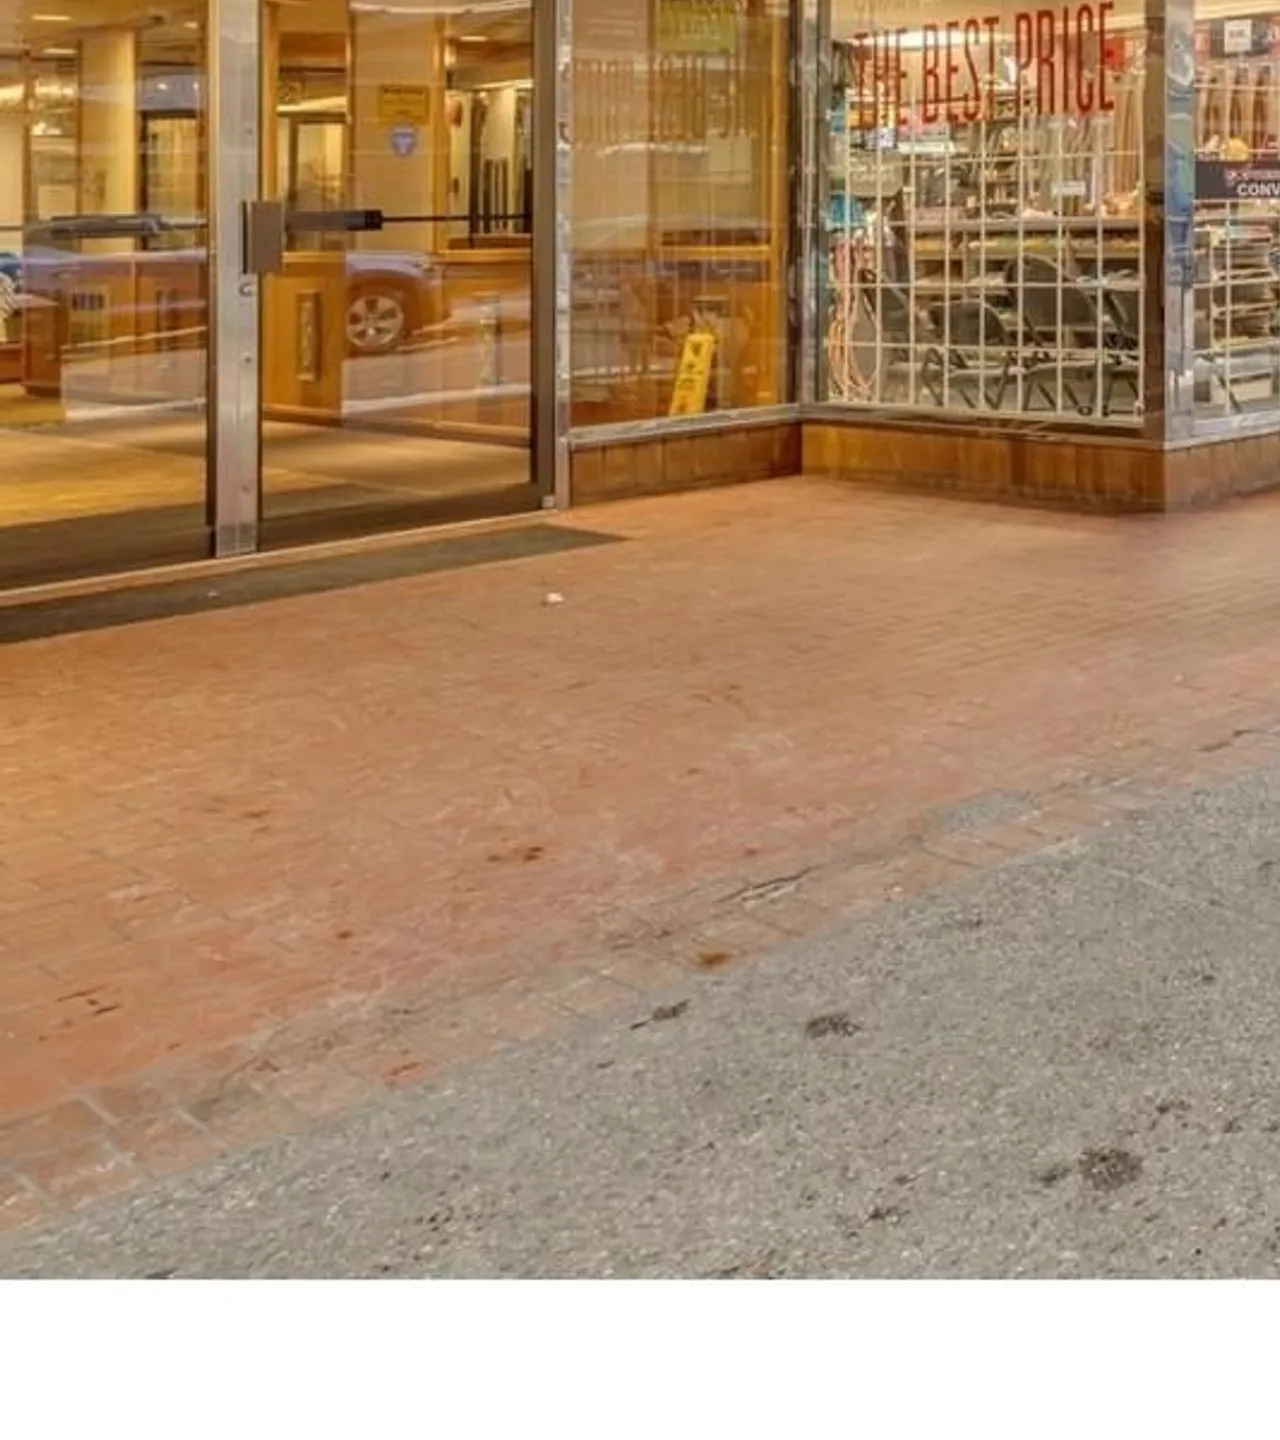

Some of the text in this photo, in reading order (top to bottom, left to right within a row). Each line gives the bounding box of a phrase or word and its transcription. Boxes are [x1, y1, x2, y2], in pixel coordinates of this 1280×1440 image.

[853, 1, 1115, 131] THE BEST PRICE
